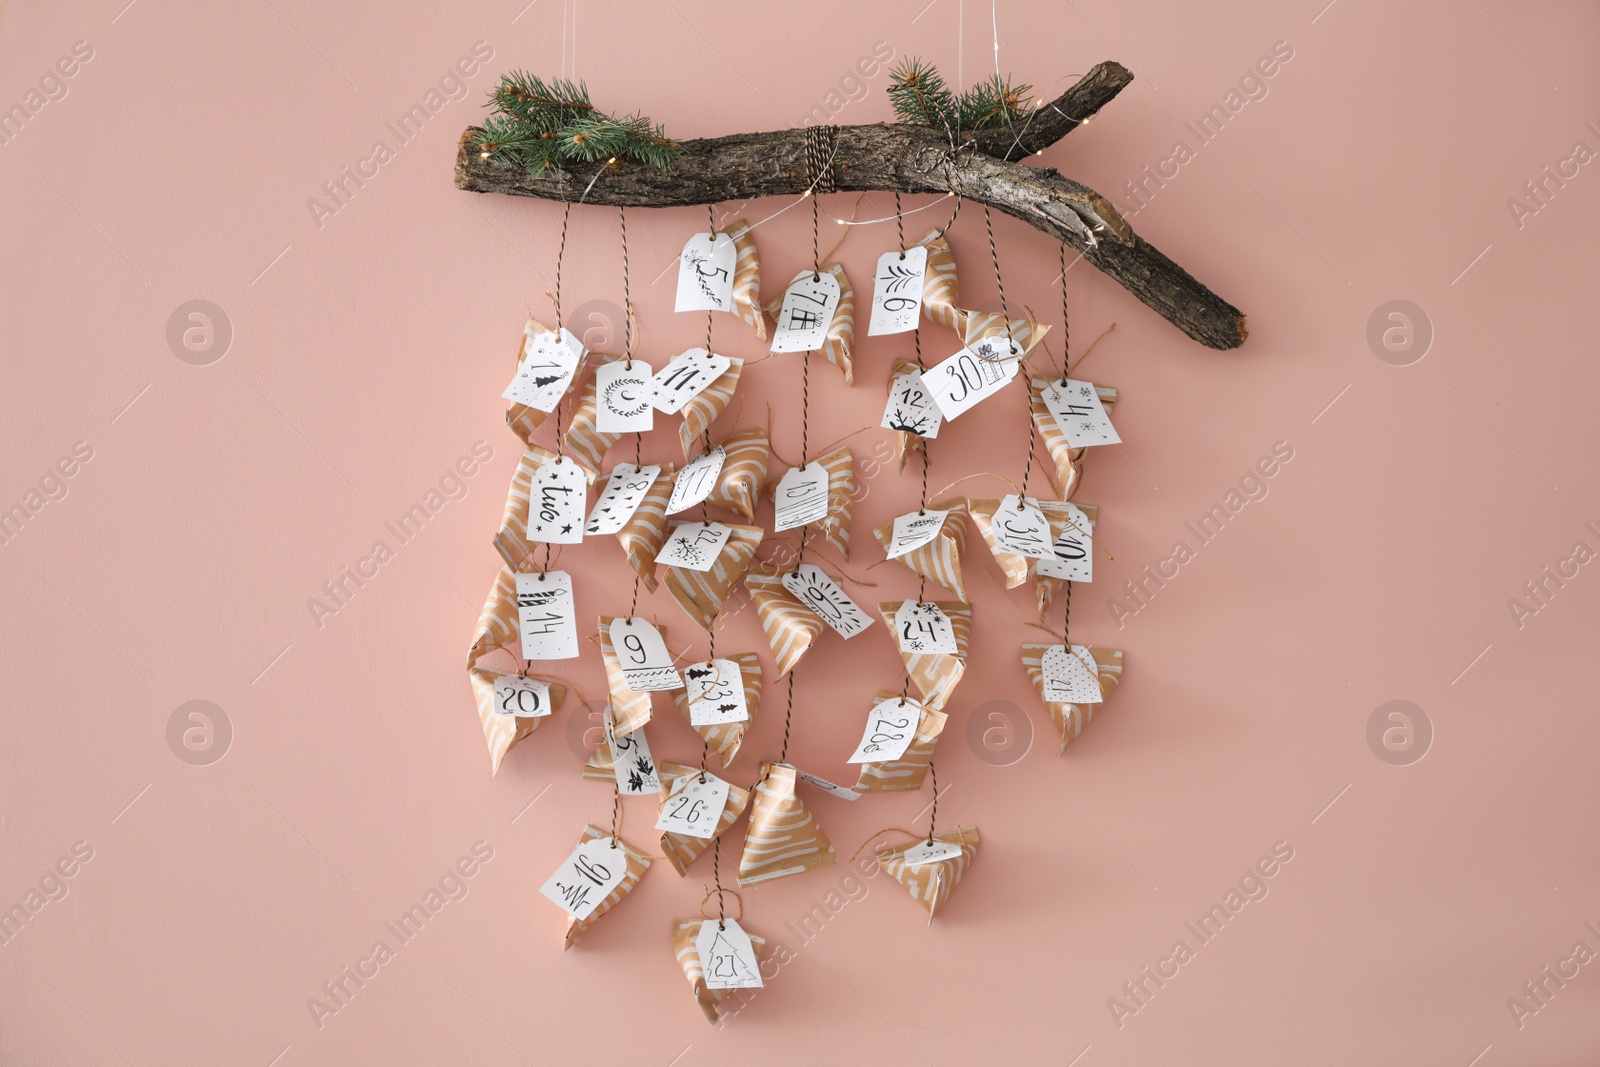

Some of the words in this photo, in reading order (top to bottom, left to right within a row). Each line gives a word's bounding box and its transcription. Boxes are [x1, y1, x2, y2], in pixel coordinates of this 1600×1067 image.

[698, 259, 728, 283] 5
[791, 292, 828, 306] 7
[531, 361, 562, 370] 1
[663, 366, 700, 391] 11
[946, 355, 983, 402] 30
[901, 387, 924, 409] 12
[1059, 404, 1094, 416] 4
[626, 480, 649, 491] 8
[681, 464, 712, 502] 17
[786, 481, 818, 498] 13
[694, 529, 722, 546] 22
[1004, 519, 1044, 544] 31
[1053, 535, 1087, 560] 10
[802, 586, 842, 623] 19
[526, 612, 565, 636] 14
[903, 620, 937, 643] 24
[623, 634, 647, 664] 9
[502, 686, 540, 713] 20
[700, 680, 733, 701] 23
[870, 718, 909, 744] 28
[669, 796, 704, 823] 26
[573, 854, 612, 887] 16
[714, 954, 738, 978] 27
